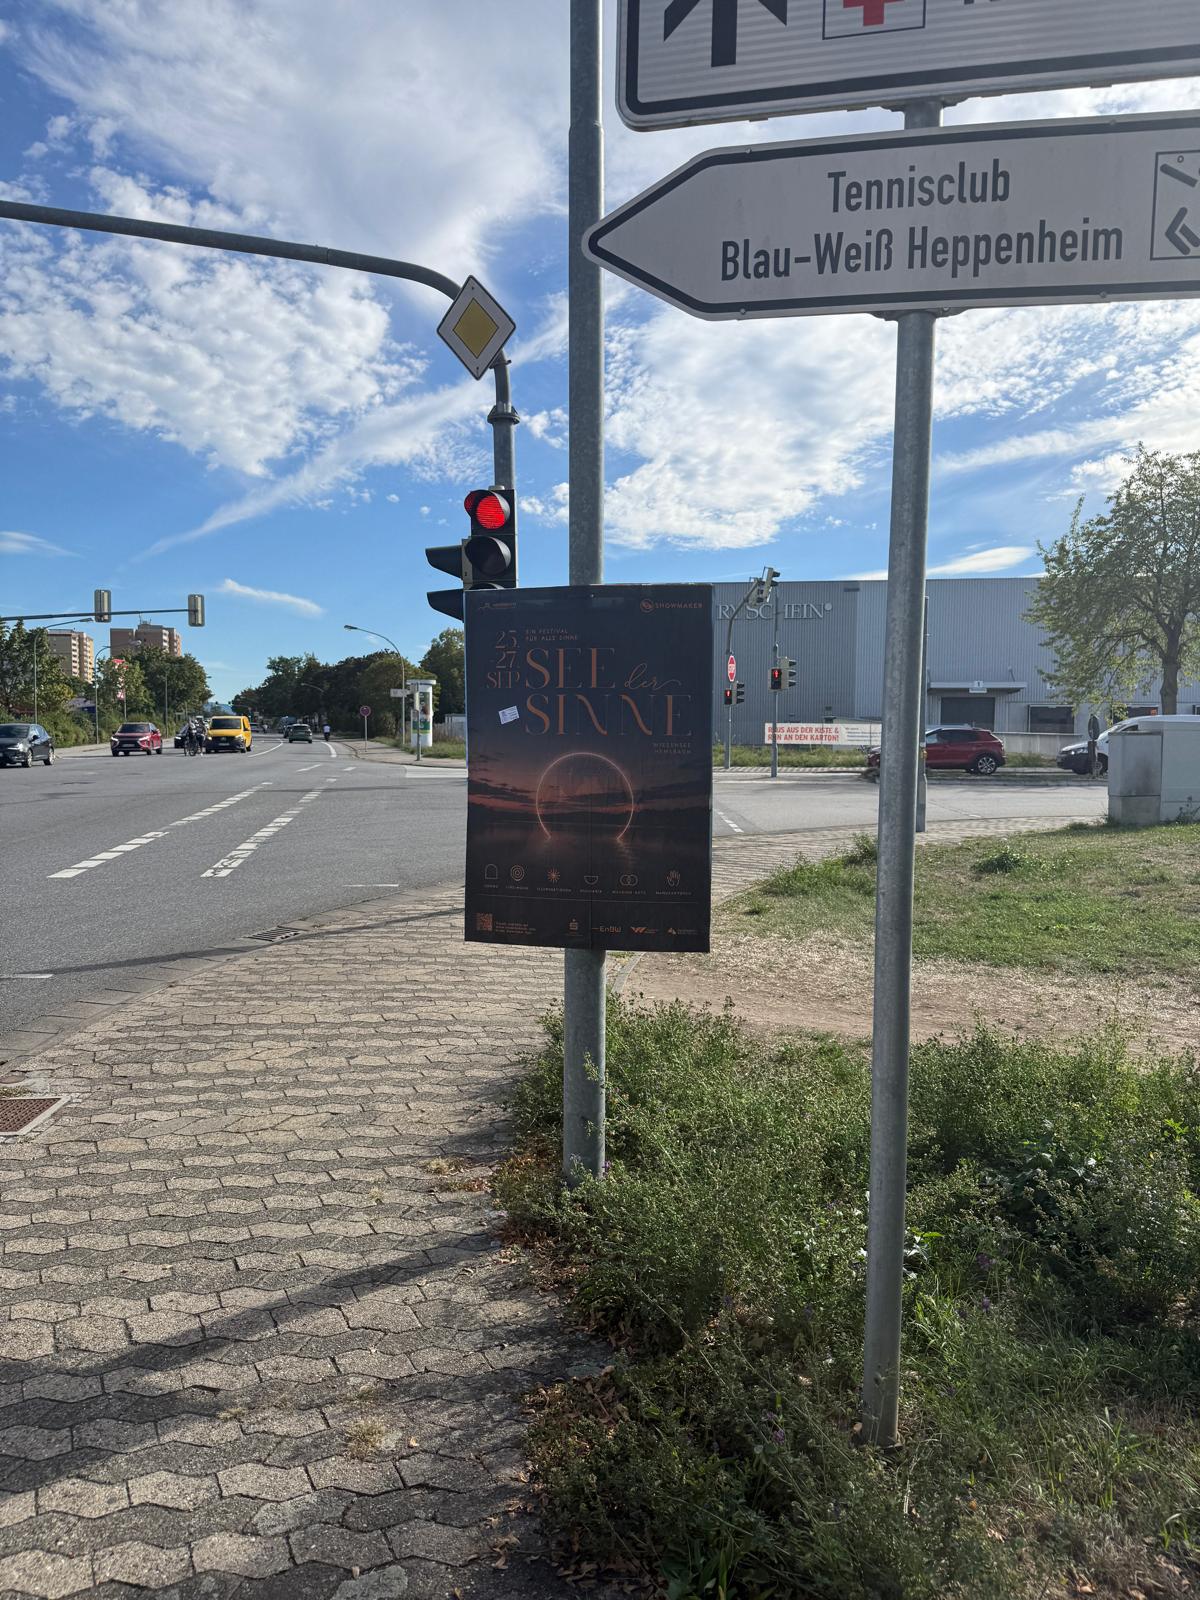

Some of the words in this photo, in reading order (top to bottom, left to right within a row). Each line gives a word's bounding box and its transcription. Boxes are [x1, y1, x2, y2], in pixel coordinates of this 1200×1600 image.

[827, 158, 1010, 213] Tennisclub
[721, 226, 893, 281] Blau-Weiß
[907, 217, 1123, 278] Heppenheim
[486, 671, 520, 689] SEP
[525, 647, 616, 689] SEE
[624, 663, 682, 690] der
[525, 693, 692, 736] SINNE
